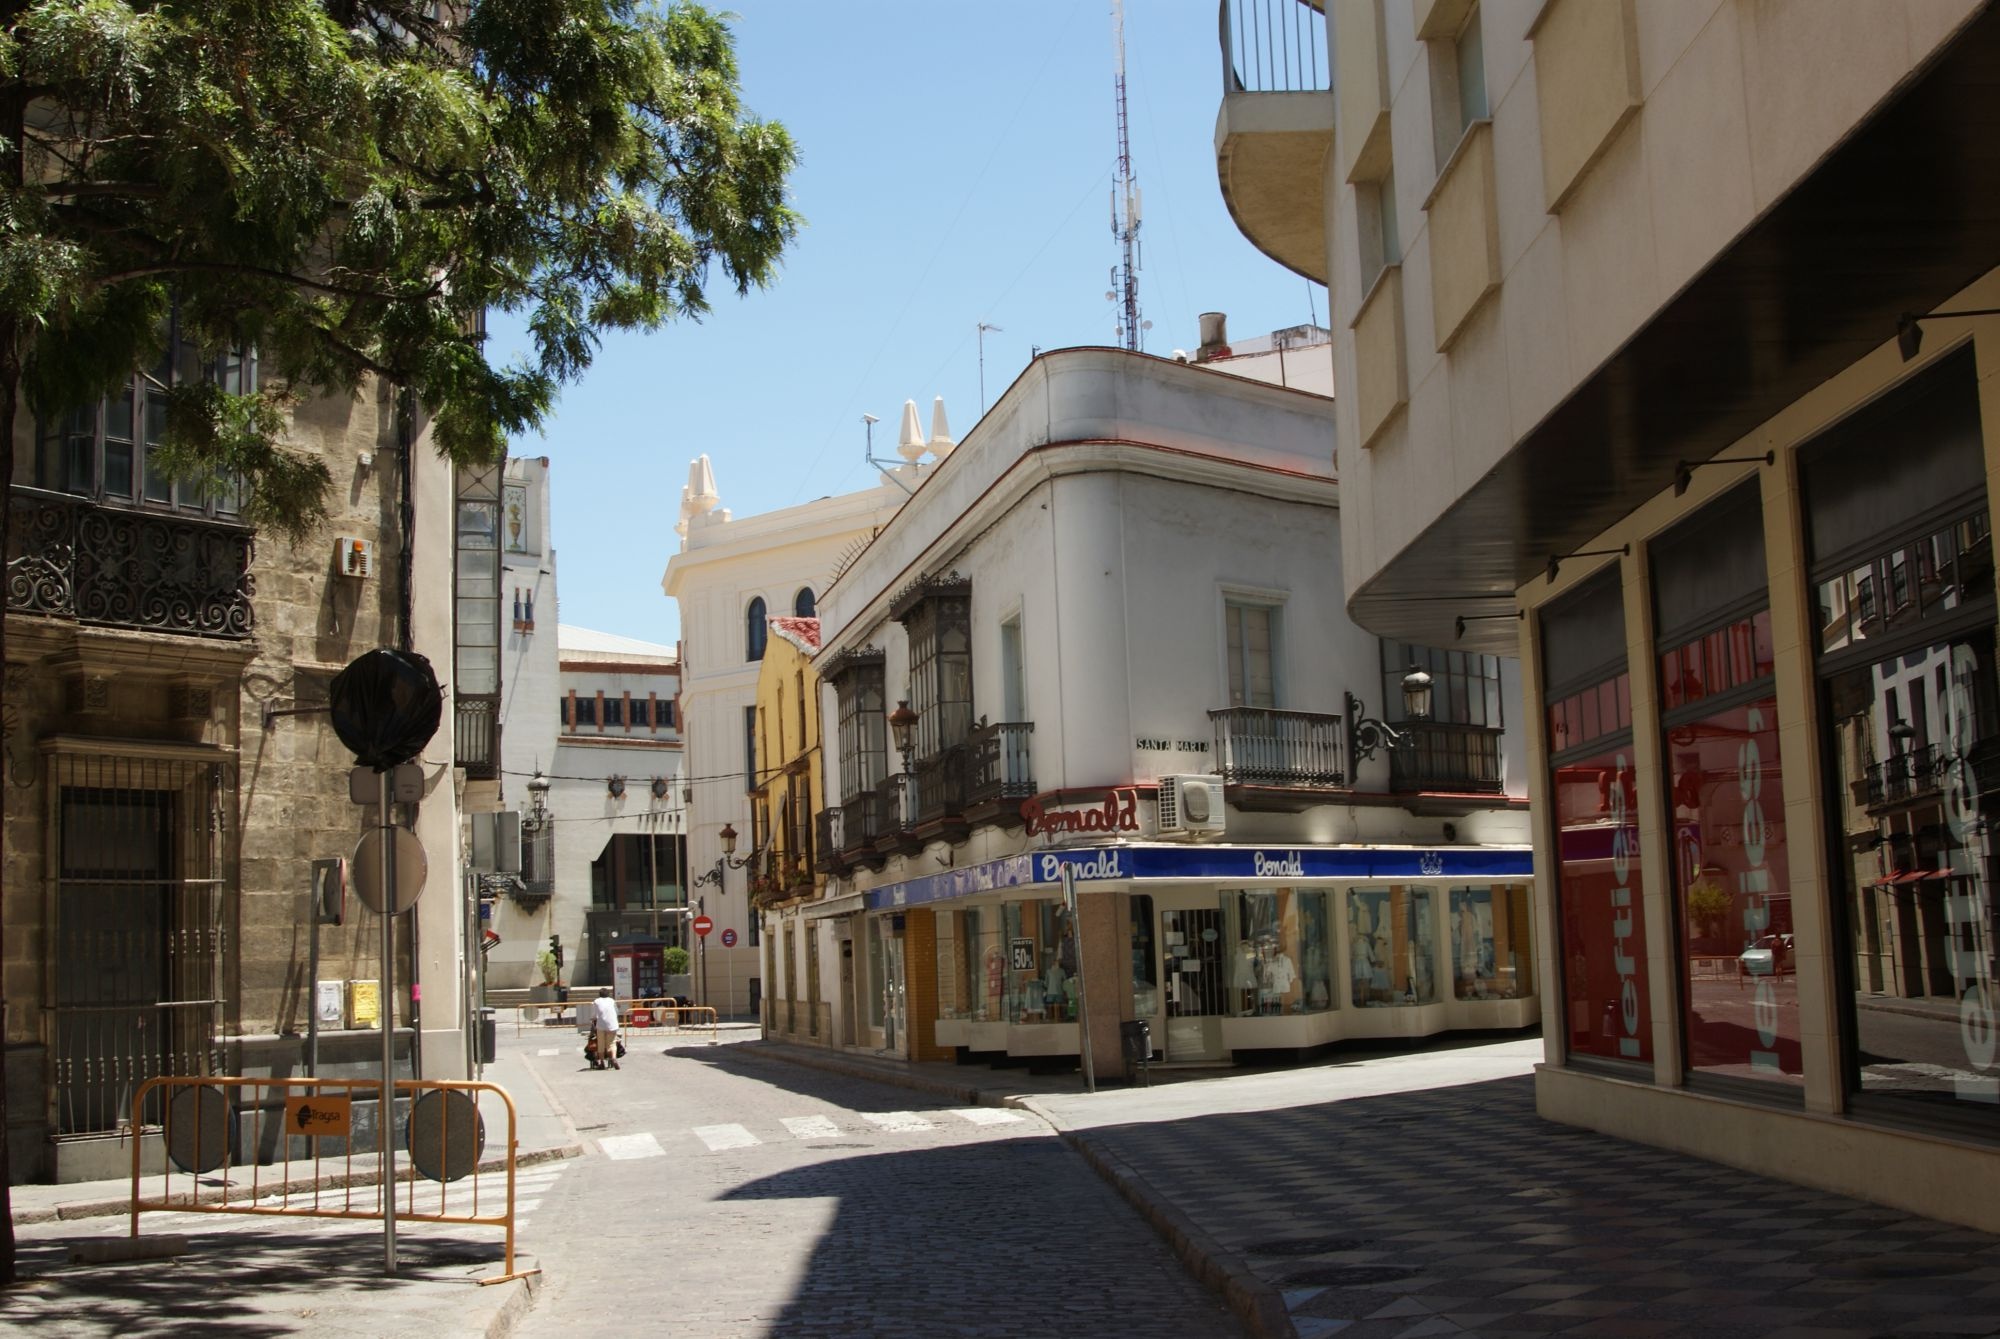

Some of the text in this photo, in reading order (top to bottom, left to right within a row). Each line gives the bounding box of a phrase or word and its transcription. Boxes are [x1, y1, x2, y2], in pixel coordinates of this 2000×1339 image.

[1137, 738, 1171, 751] SANTA
[1020, 789, 1139, 838] Donald
[1041, 850, 1123, 881] Dnald
[1254, 851, 1305, 877] Donald
[1014, 948, 1033, 969] 50%
[311, 1109, 341, 1124] Tragsa
